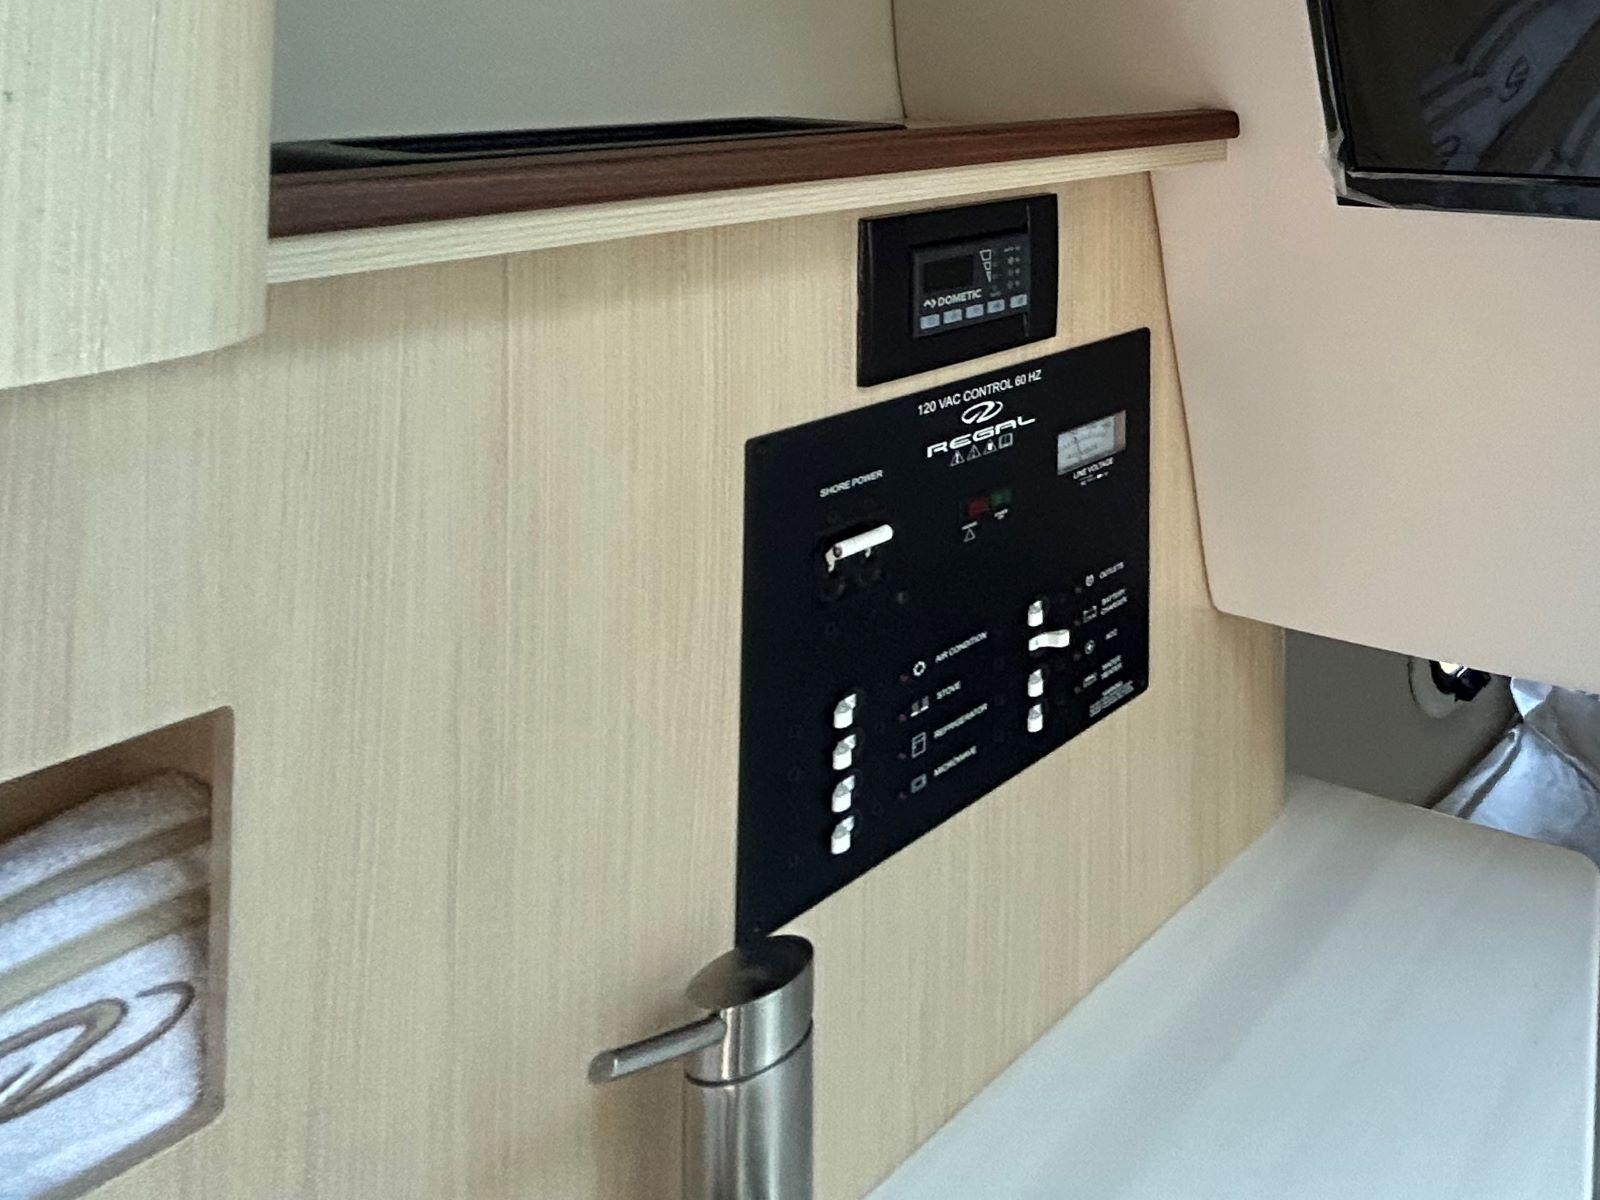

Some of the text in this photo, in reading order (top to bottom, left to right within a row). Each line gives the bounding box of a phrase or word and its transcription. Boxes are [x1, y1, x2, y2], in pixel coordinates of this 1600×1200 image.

[938, 288, 983, 307] DOMETIC
[918, 369, 1042, 416] 120 VAC CONTROL 60 HZ
[927, 416, 1036, 458] REGAL
[820, 469, 883, 498] SHORE POWER
